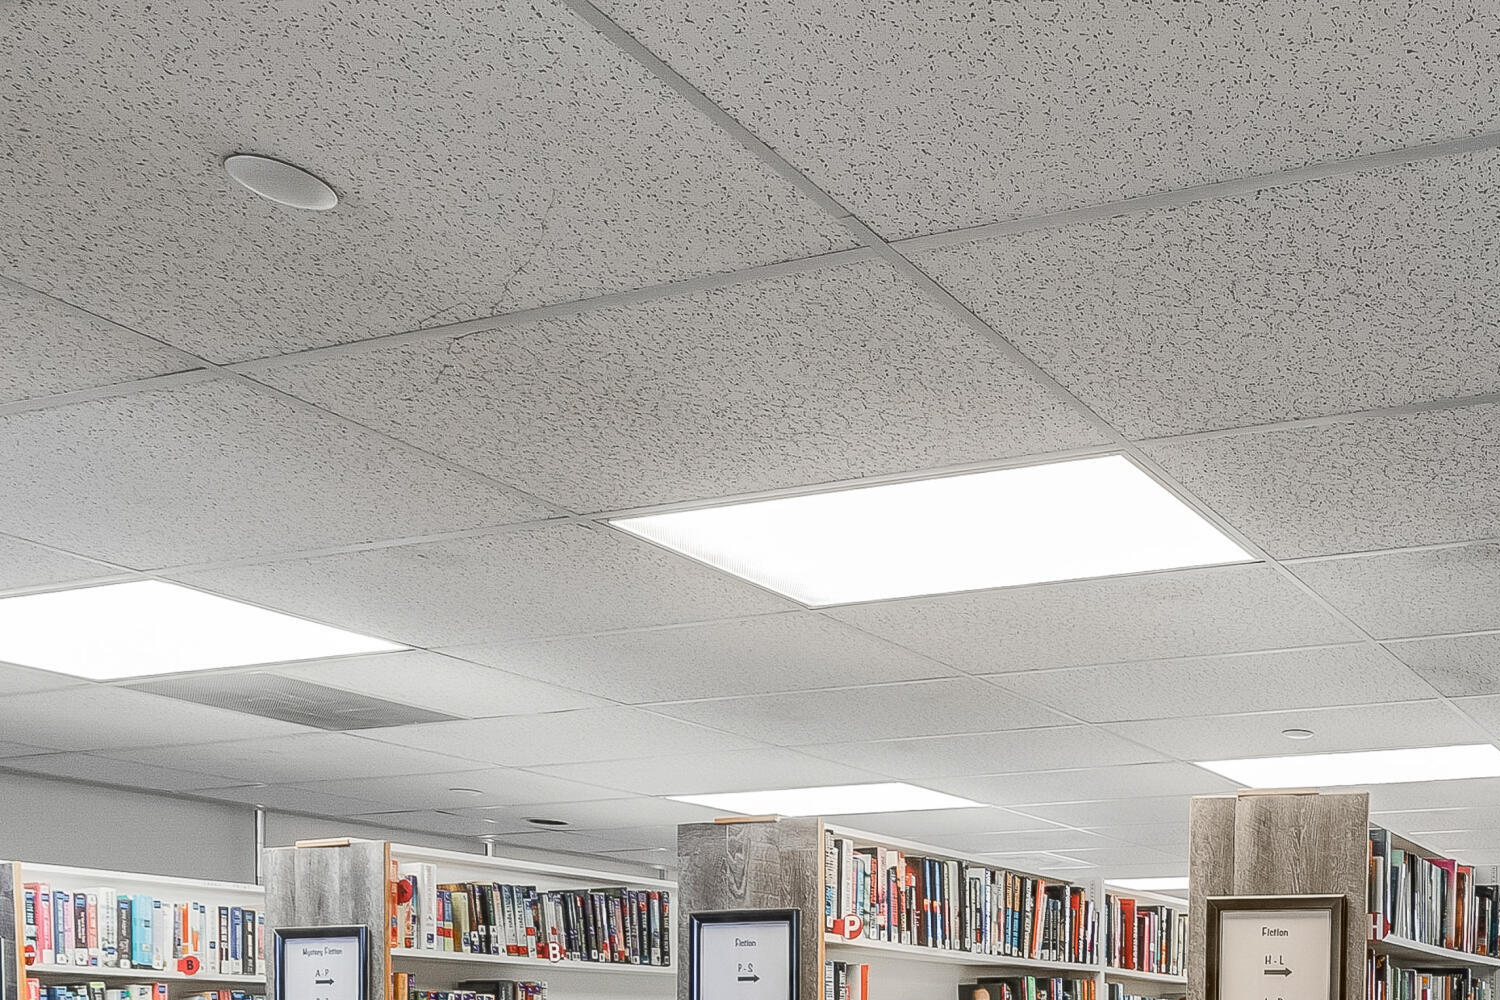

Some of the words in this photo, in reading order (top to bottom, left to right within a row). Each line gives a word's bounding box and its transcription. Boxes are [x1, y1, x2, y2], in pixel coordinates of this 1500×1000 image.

[844, 915, 861, 939] P
[1262, 927, 1289, 937] Fiction
[1367, 913, 1383, 941] H
[735, 938, 757, 947] Fiction
[187, 960, 194, 970] B
[1265, 955, 1272, 965] H
[1279, 955, 1284, 965] L
